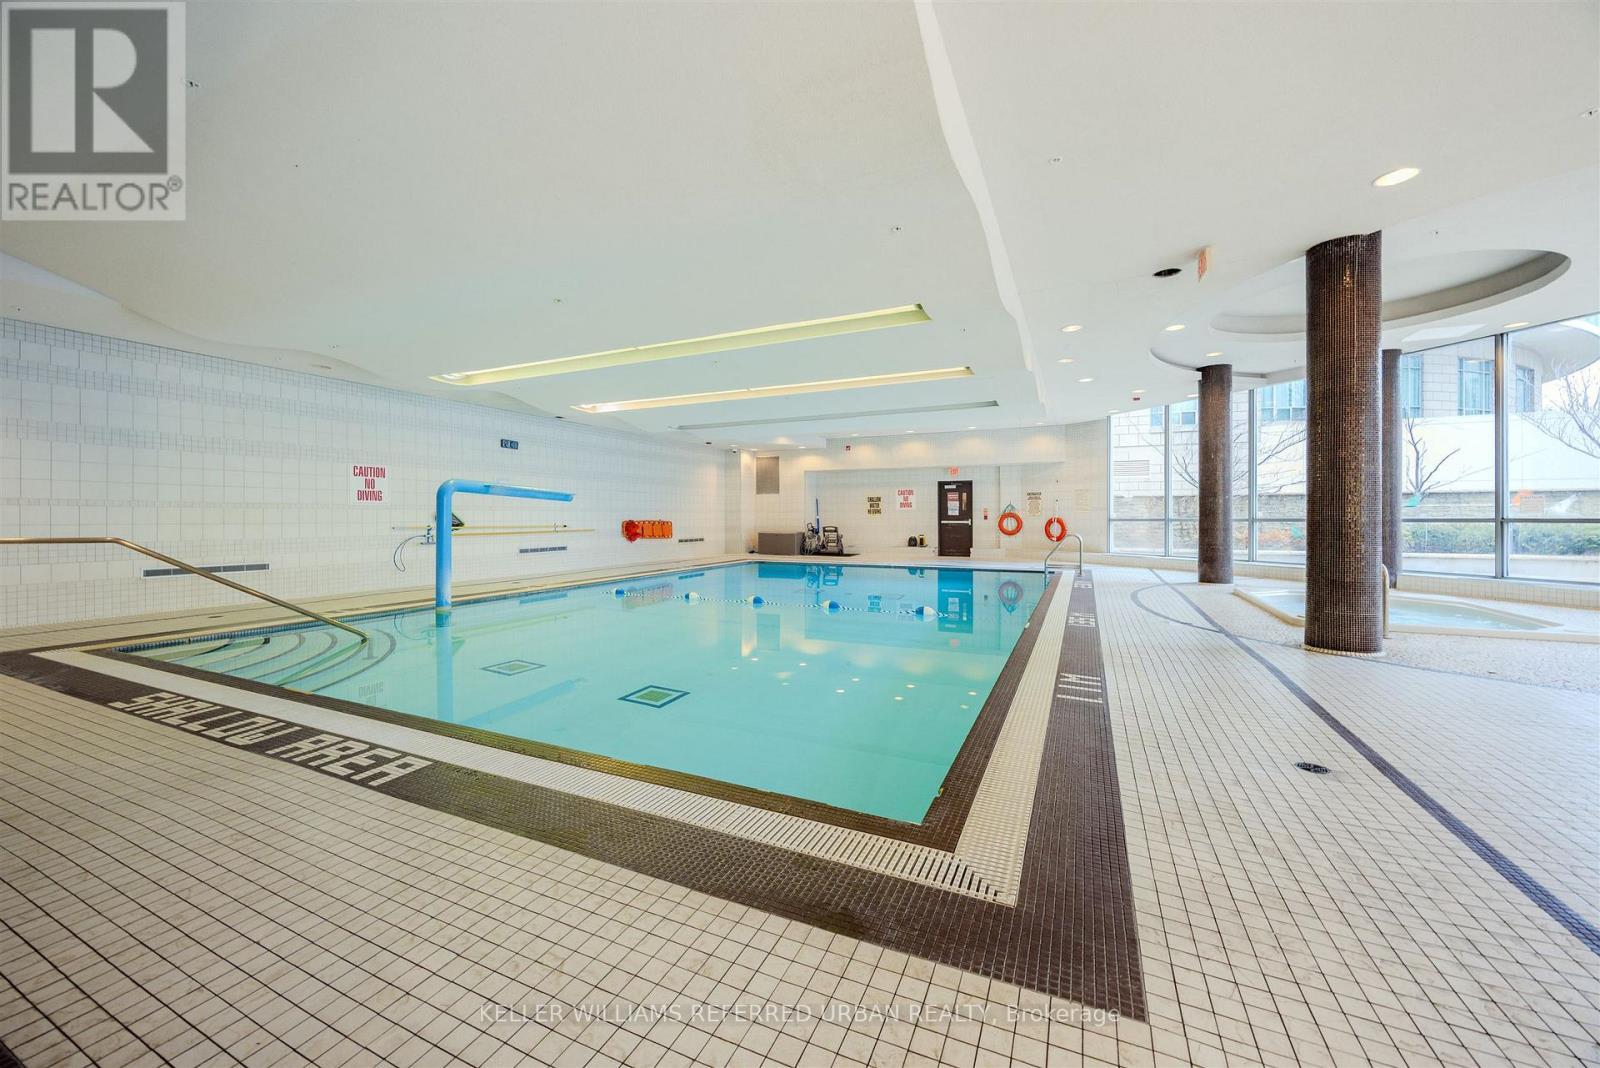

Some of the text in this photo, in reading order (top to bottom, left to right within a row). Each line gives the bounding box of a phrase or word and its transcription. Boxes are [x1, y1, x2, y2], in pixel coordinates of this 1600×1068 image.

[353, 465, 386, 479] CAUTION
[364, 478, 376, 489] NO
[357, 489, 383, 501] DIVING
[107, 691, 435, 787] SHALLOW AREA
